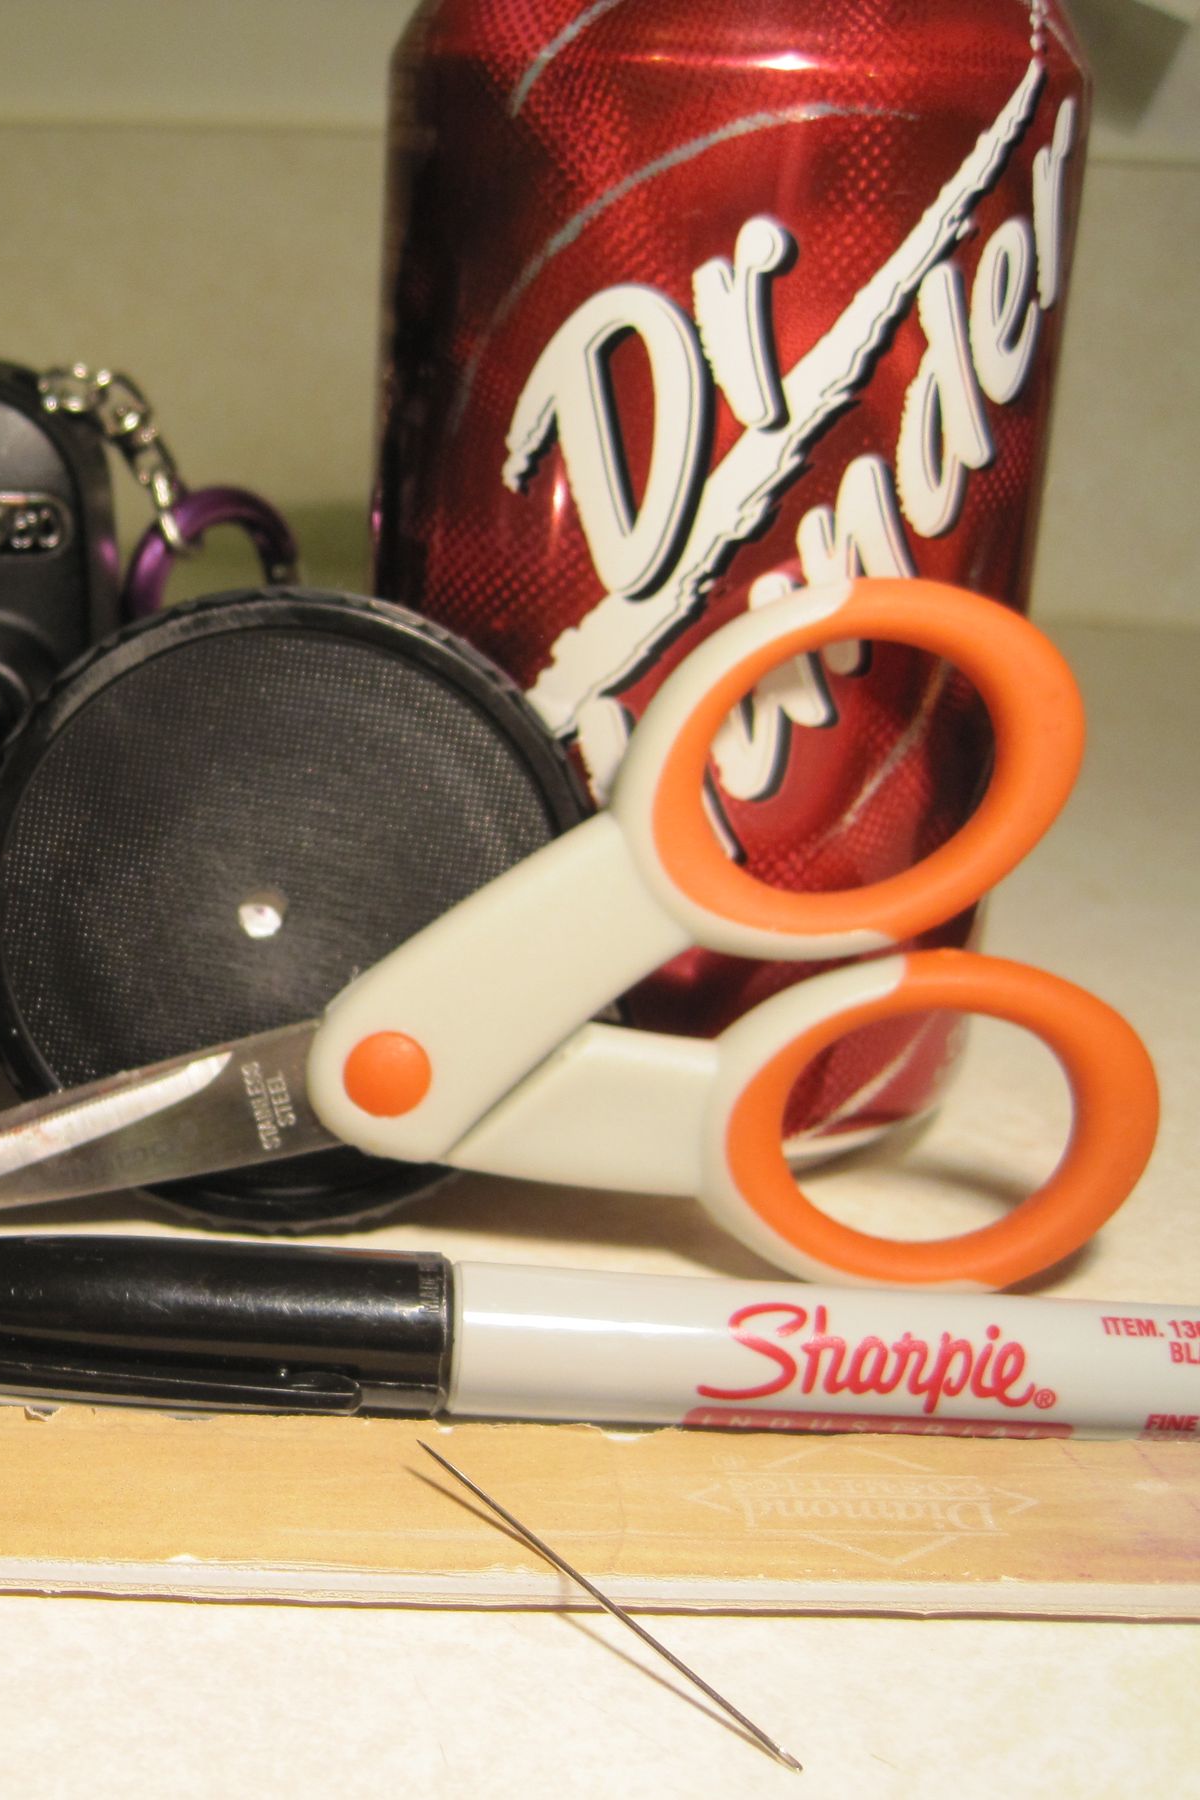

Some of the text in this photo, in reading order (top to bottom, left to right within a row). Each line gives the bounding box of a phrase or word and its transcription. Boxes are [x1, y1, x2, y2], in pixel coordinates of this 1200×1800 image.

[502, 284, 796, 601] Dr
[241, 1061, 281, 1150] STAINLESS
[266, 1070, 296, 1127] STEEL
[1100, 1316, 1165, 1337] ITEM.
[696, 1302, 1036, 1414] Sharpie
[1169, 1341, 1200, 1364] BL
[1143, 1414, 1200, 1432] FINE
[739, 1499, 1003, 1532] Diamond
